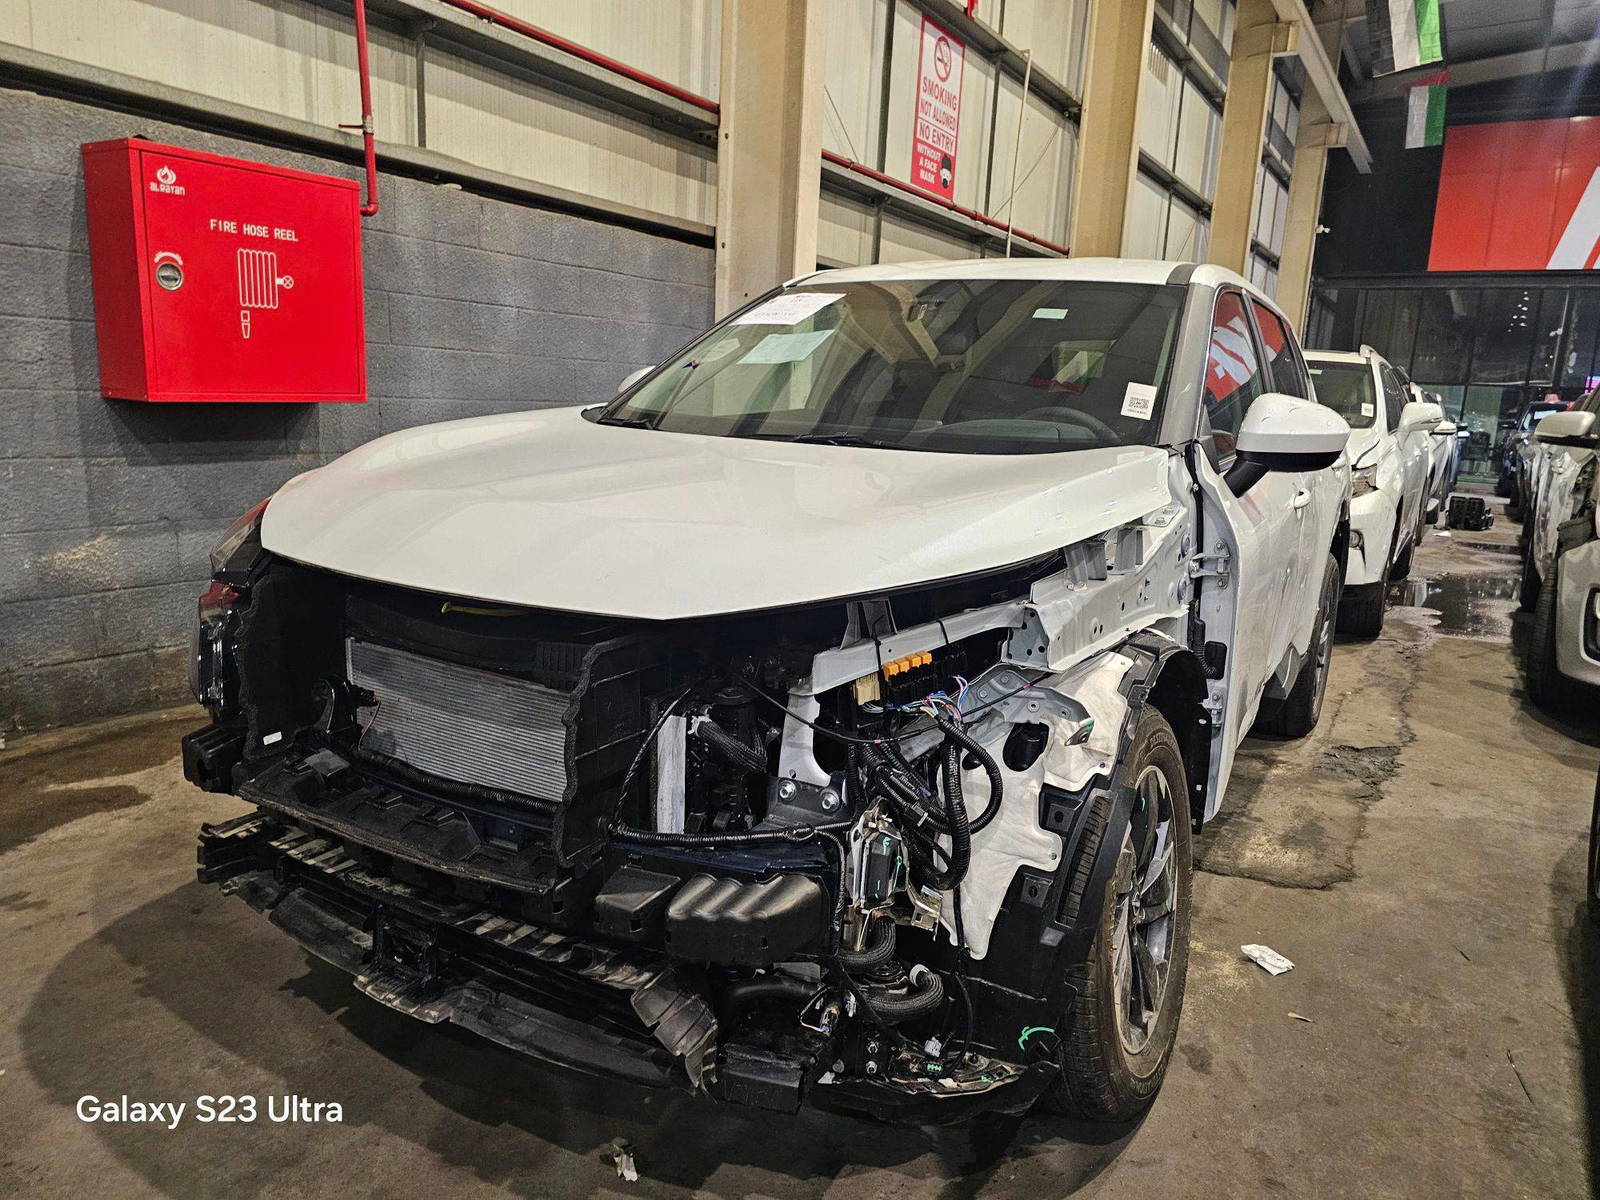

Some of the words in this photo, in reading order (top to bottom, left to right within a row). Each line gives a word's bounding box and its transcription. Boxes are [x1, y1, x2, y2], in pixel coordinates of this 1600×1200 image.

[922, 76, 957, 111] SMOKING
[920, 98, 932, 117] NOT
[932, 105, 956, 131] ALLOWED
[919, 121, 930, 140] NO
[931, 128, 955, 153] ENTRY
[210, 218, 237, 234] FIRE
[243, 223, 269, 238] HOSE
[274, 227, 299, 242] REEL
